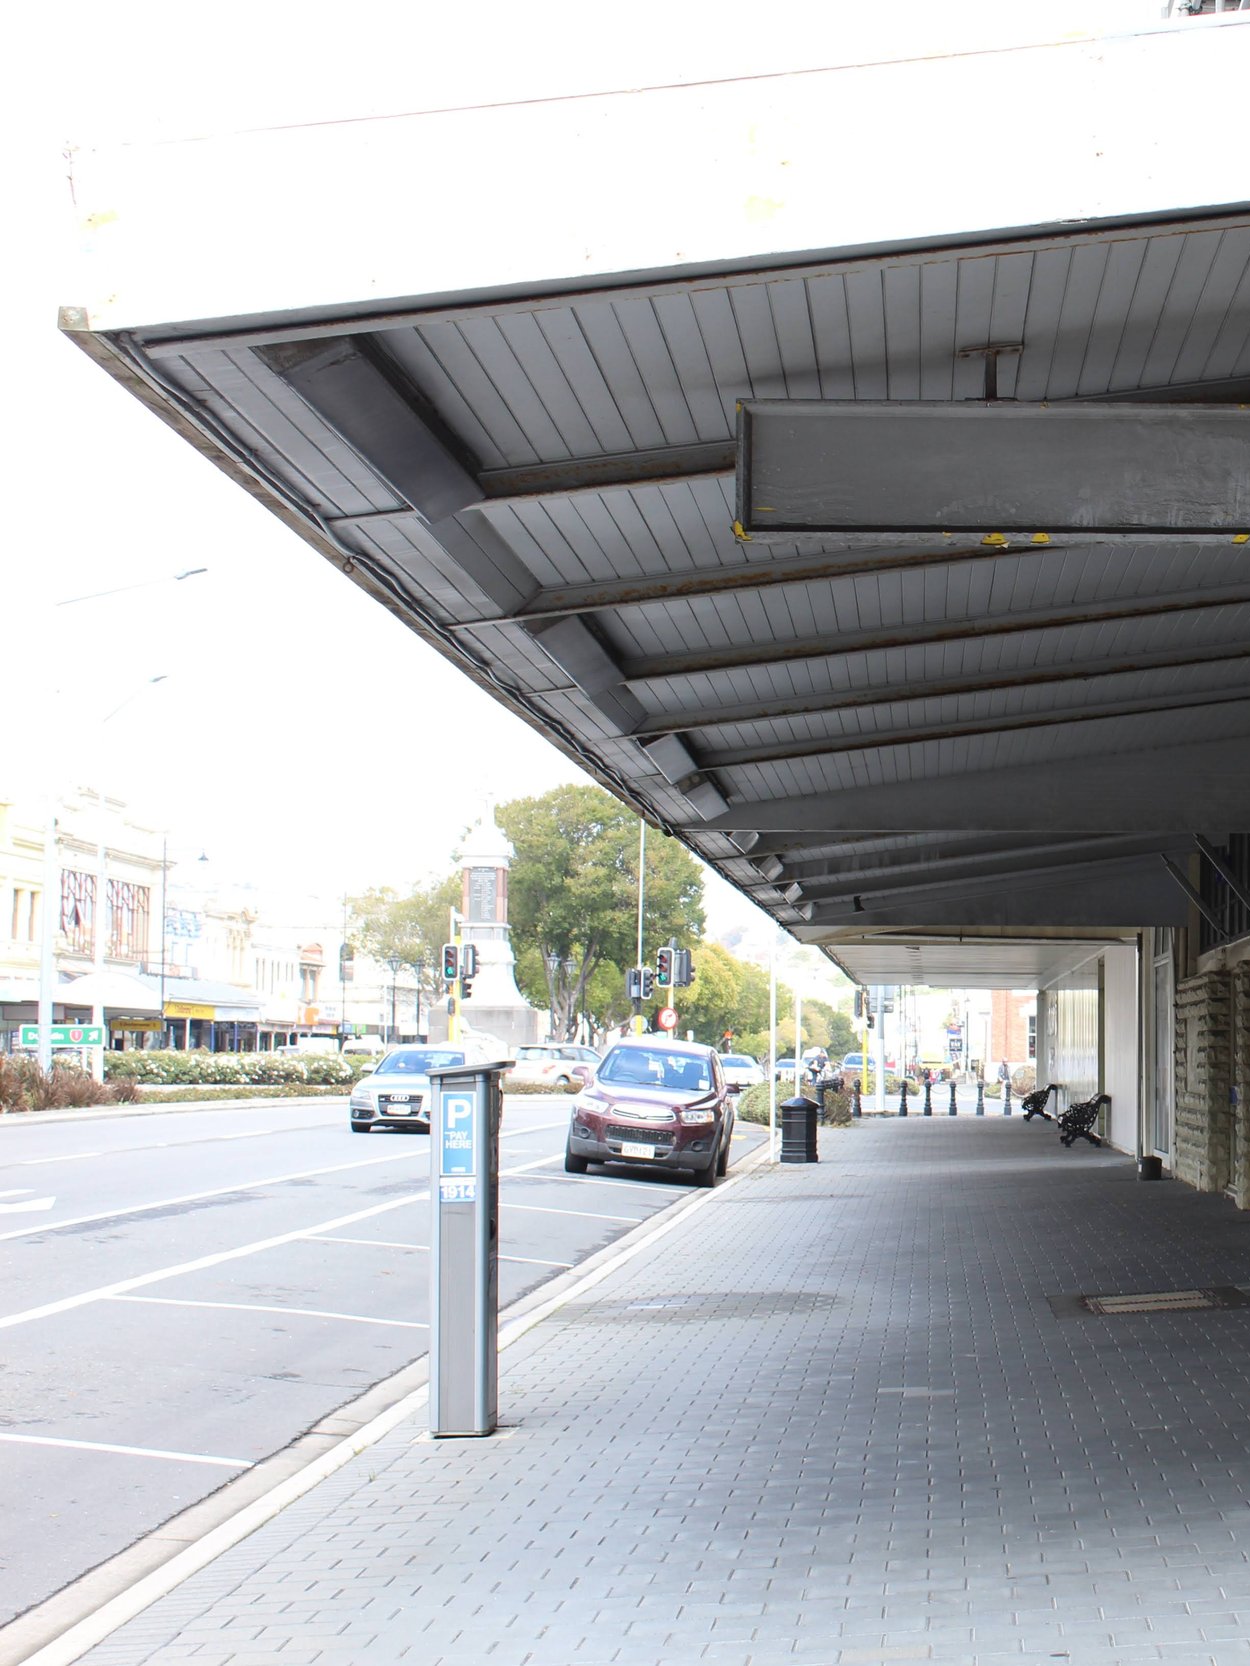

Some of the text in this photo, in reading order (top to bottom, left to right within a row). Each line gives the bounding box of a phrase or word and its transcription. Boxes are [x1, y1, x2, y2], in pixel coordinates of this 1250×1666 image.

[447, 1098, 472, 1129] P
[449, 1131, 468, 1140] PAY
[445, 1140, 472, 1149] HERE
[440, 1185, 476, 1199] 1914
